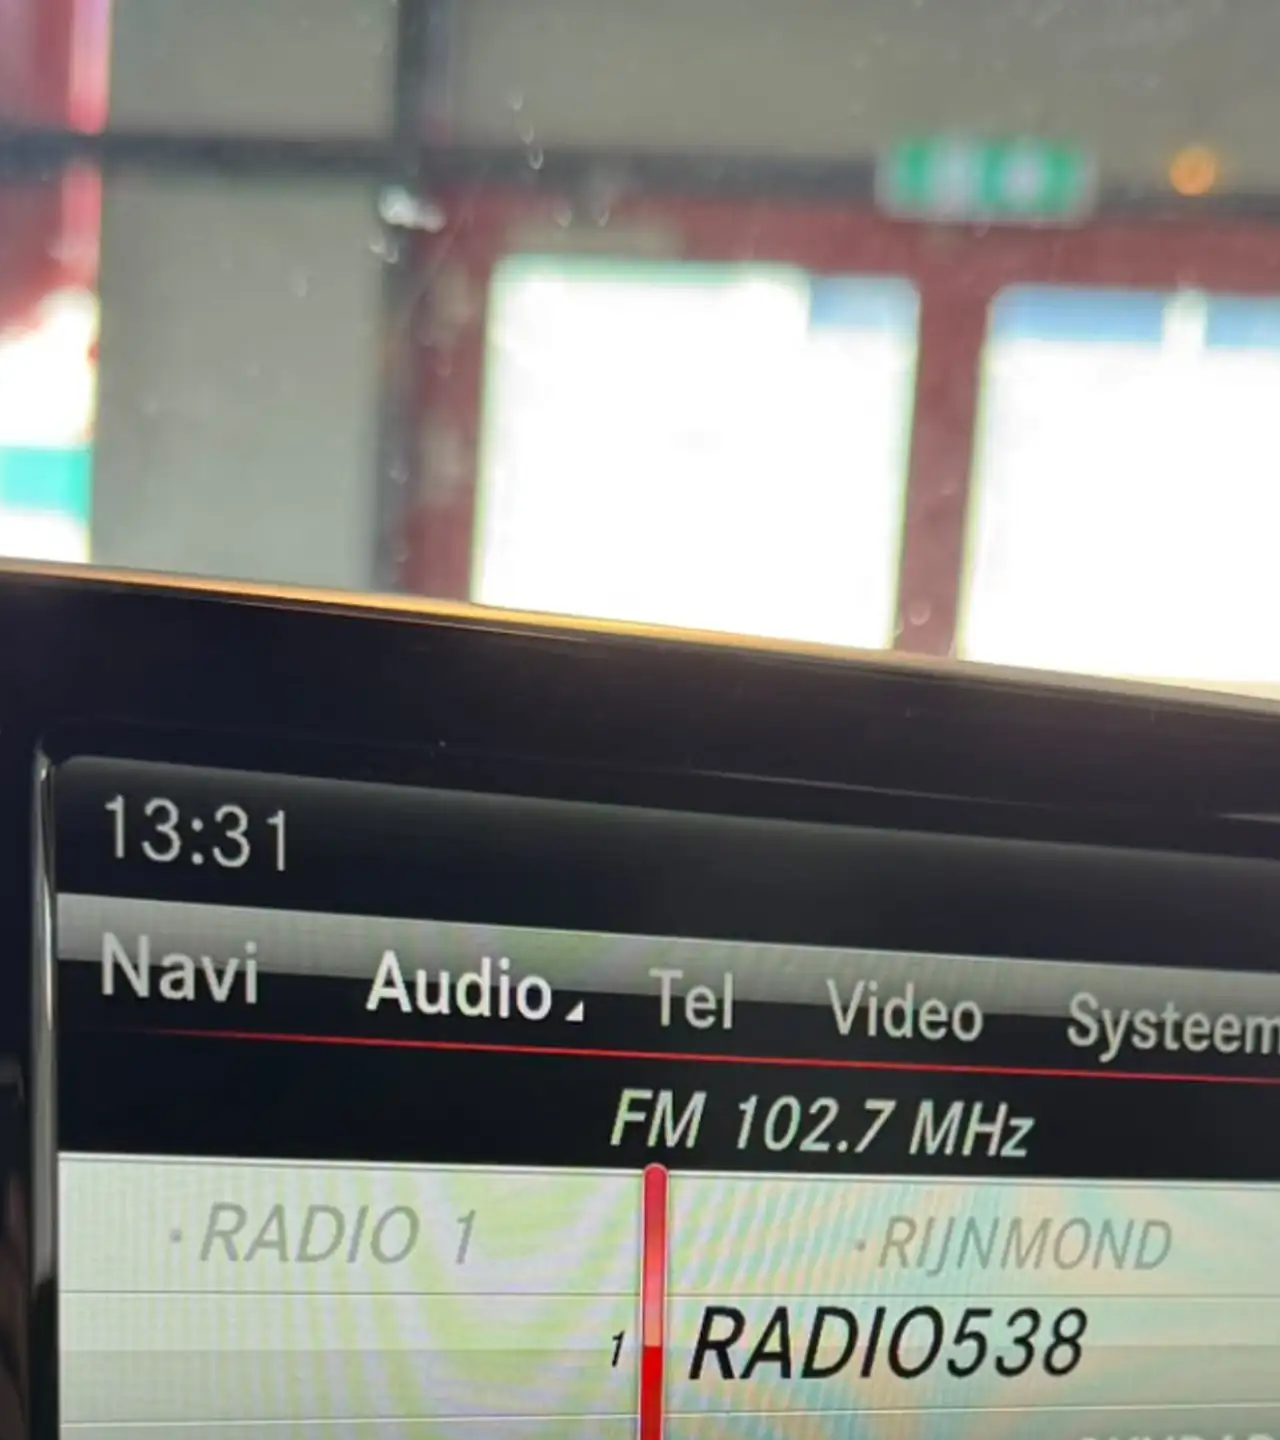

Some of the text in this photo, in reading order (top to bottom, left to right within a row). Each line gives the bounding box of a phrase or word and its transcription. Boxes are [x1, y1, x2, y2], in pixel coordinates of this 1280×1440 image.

[104, 795, 287, 872] 13:31
[100, 931, 259, 1004] Navi
[365, 949, 553, 1020] Audio
[649, 967, 734, 1029] Tel
[826, 977, 984, 1042] Video
[609, 1088, 1035, 1158] FM 102.7 MHz
[198, 1203, 478, 1266] RADIO 1
[876, 1216, 1173, 1277] RIJNMOND
[609, 1330, 625, 1369] 1
[688, 1305, 1089, 1382] RADIO538
